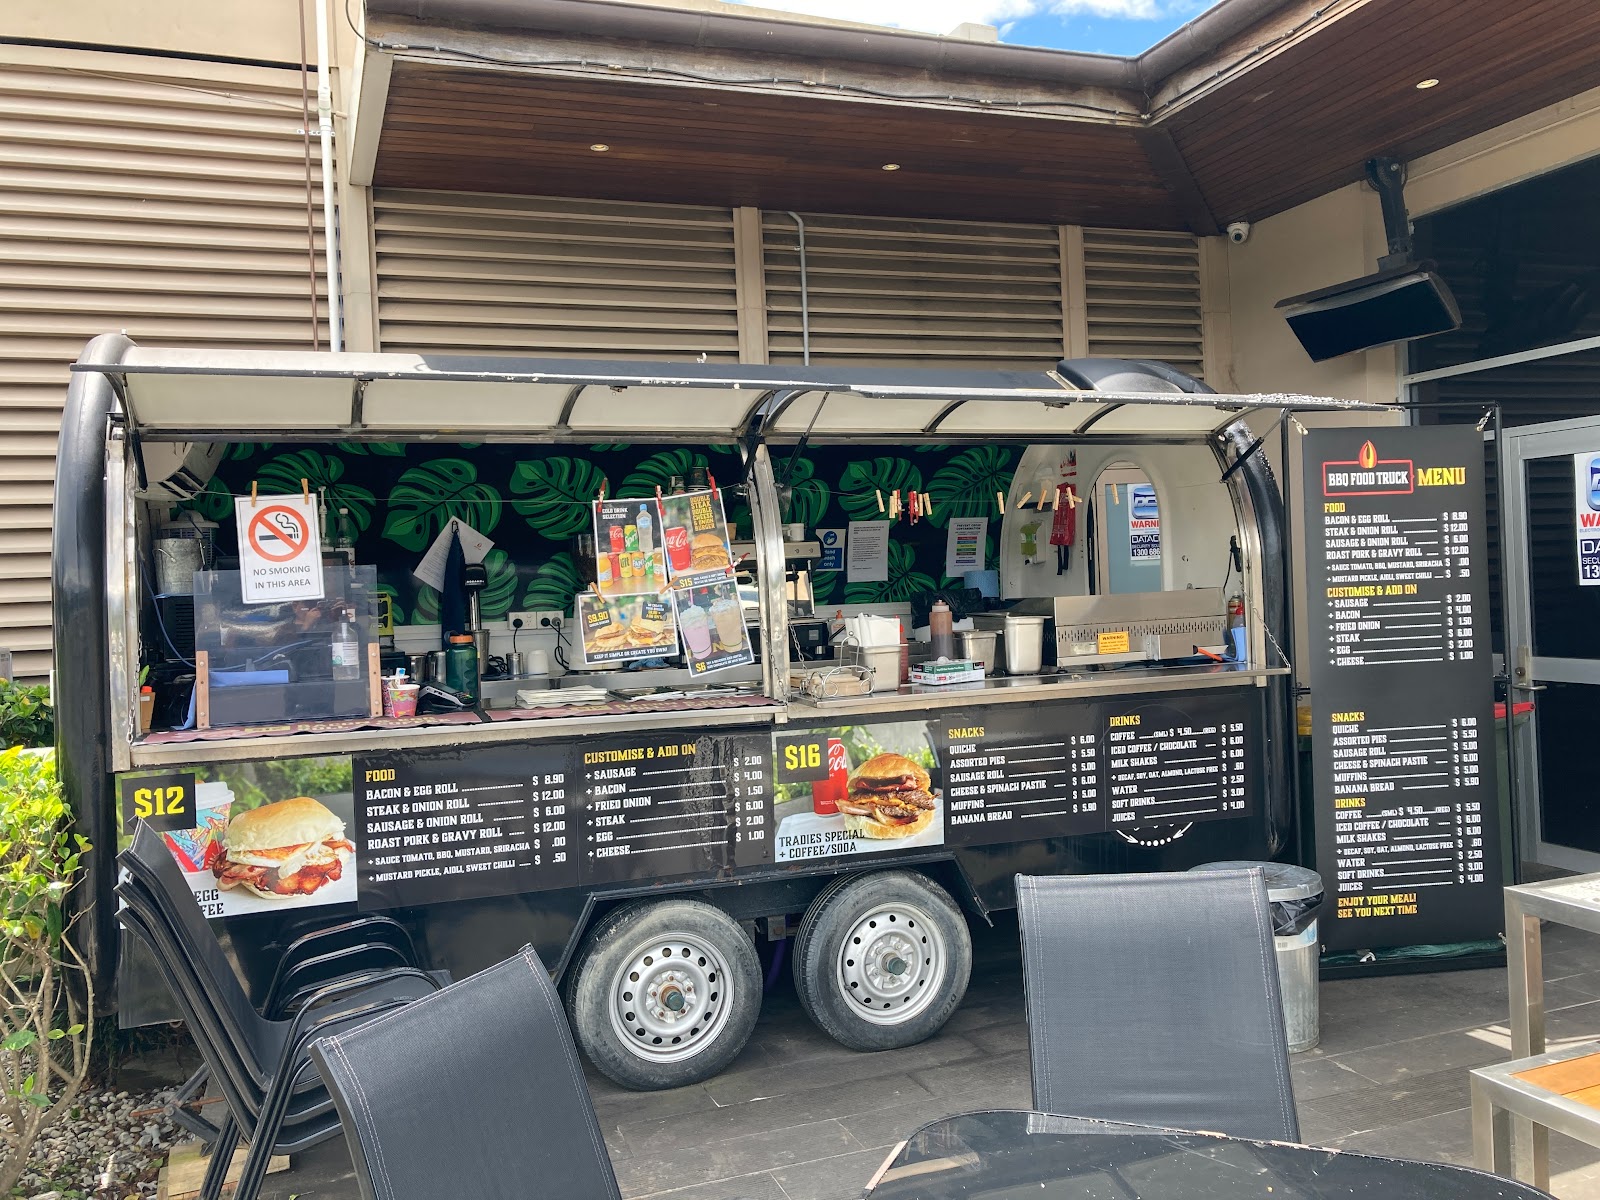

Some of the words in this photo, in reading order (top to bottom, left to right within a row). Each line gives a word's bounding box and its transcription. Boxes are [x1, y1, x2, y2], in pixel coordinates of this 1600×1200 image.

[1328, 473, 1349, 486] BBQ
[1351, 472, 1375, 486] FOOD
[1377, 471, 1409, 485] TRUCK
[1417, 467, 1466, 486] MENU
[1324, 503, 1345, 513] FOOD
[1131, 520, 1159, 528] WARNI
[1325, 516, 1350, 525] BACON
[1351, 515, 1356, 523] &
[1358, 515, 1371, 523] EGG
[1373, 514, 1390, 523] ROLL
[1132, 535, 1159, 543] DATAC
[269, 566, 310, 575] SMOKING
[267, 580, 285, 588] THIS
[288, 579, 310, 587] AREA
[679, 578, 693, 587] $15
[1327, 586, 1375, 597] CUSTOMISE
[1377, 586, 1383, 596] &
[1386, 585, 1403, 595] ADD
[1405, 584, 1417, 594] ON
[587, 611, 608, 623] $9.90
[695, 662, 706, 672] $6
[1110, 715, 1140, 727] DRINKS
[1332, 712, 1365, 723] SNACKS
[948, 727, 985, 739] SNACKS
[1333, 724, 1359, 734] QUICHE
[1110, 732, 1135, 742] COFFEE
[584, 748, 644, 764] CUSTOMISE
[647, 748, 654, 759] &
[657, 745, 678, 758] ADD
[681, 744, 696, 755] ON
[950, 744, 976, 755] QUICHE
[1111, 745, 1126, 755] ICED
[1128, 743, 1152, 753] COFFEE
[1153, 743, 1158, 752] /
[1159, 740, 1197, 751] CHOCOLATE
[785, 744, 821, 770] $16
[950, 757, 988, 769] ASSORTED
[989, 756, 1005, 765] PIES
[1111, 758, 1128, 768] MILK
[1130, 756, 1158, 766] SHAKES
[594, 767, 636, 780] SAUSAGE
[744, 756, 762, 765] 2.00
[365, 769, 395, 782] FOOD
[950, 771, 985, 782] SAUSAGE
[987, 770, 1004, 779] ROLL
[1334, 772, 1367, 782] MUFFINS
[366, 787, 402, 801] BACON
[404, 787, 411, 797] &
[413, 786, 432, 796] EGG
[435, 783, 458, 794] ROLL
[544, 774, 564, 784] 8.90
[595, 784, 626, 795] BACON
[744, 771, 762, 780] 4.00
[950, 786, 979, 797] CHEESE
[980, 785, 985, 794] &
[987, 782, 1019, 793] SPINACH
[1021, 779, 1046, 790] PASTIE
[1335, 785, 1368, 794] BANANA
[1370, 782, 1395, 792] BREAD
[1112, 785, 1138, 795] WATER
[134, 785, 185, 819] $12
[367, 804, 400, 817] STEAK
[403, 803, 409, 814] &
[412, 800, 443, 812] ONION
[447, 798, 470, 809] ROLL
[542, 789, 565, 800] 12.00
[595, 799, 621, 811] FRIED
[623, 796, 651, 808] ONION
[747, 785, 763, 795] 1.50
[1112, 799, 1128, 809] SOFT
[1130, 797, 1155, 807] DRINKS
[1335, 798, 1365, 808] DRINKS
[951, 799, 984, 811] MUFFINS
[367, 819, 414, 833] SAUSAGE
[417, 819, 424, 829] &
[426, 815, 457, 828] ONION
[461, 813, 483, 824] ROLL
[545, 805, 565, 816] 6.00
[596, 814, 626, 827] STEAK
[745, 800, 763, 810] 6.00
[951, 813, 985, 825] BANANA
[988, 811, 1012, 822] BREAD
[1112, 812, 1135, 822] JUICES
[596, 832, 613, 842] EGG
[746, 815, 764, 825] 2.00
[368, 836, 401, 850] ROAST
[404, 834, 430, 846] PORK
[432, 833, 439, 844] &
[442, 830, 476, 843] GRAVY
[480, 827, 503, 839] ROLL
[542, 821, 565, 832] 12.00
[779, 832, 822, 847] TRADIES
[825, 829, 865, 840] SPECIAL
[1336, 835, 1355, 844] MILK
[1357, 832, 1386, 842] SHAKES
[596, 845, 631, 858] CHEESE
[748, 830, 764, 840] 1.00
[790, 842, 856, 859] COFFEE/SODA
[375, 856, 400, 866] SAUCE
[402, 853, 435, 863] TOMATO,
[437, 850, 453, 861] BBQ,
[455, 847, 492, 858] MUSTARD,
[494, 842, 530, 854] SRIRACHA
[376, 871, 413, 882] MUSTARD
[415, 868, 441, 879] PICKLE,
[444, 866, 464, 876] AIOLI,
[466, 863, 491, 873] SWEET
[493, 860, 515, 870] CHILLI
[194, 889, 219, 902] EGG
[1338, 896, 1364, 907] ENJOY
[1367, 895, 1388, 906] YOUR
[1391, 893, 1416, 904] MEAL!
[200, 903, 224, 915] FEE
[1338, 909, 1352, 918] SEE
[1355, 907, 1371, 917] YOU
[1373, 906, 1395, 916] NEXT
[1397, 905, 1418, 915] TIME
